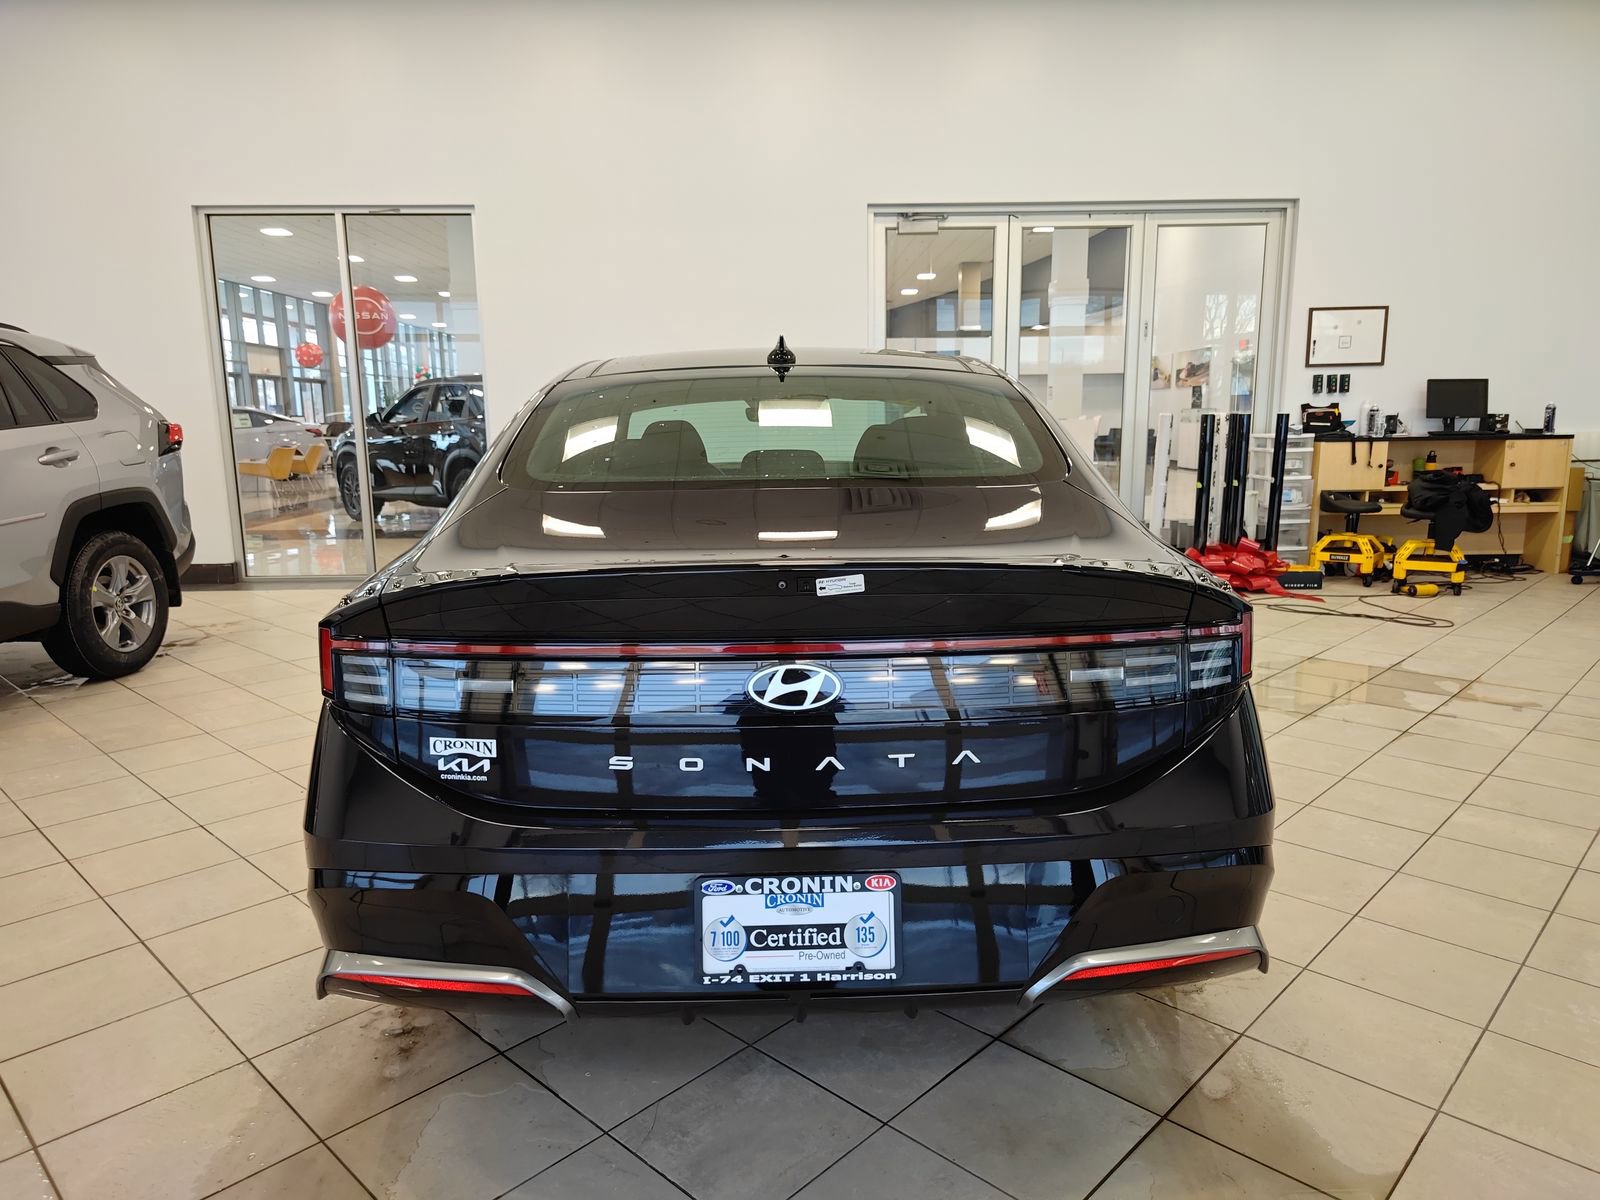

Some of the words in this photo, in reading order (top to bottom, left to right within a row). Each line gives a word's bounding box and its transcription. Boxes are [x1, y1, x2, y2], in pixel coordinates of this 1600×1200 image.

[337, 312, 389, 321] NSSAN
[433, 739, 493, 756] CRONIN
[438, 757, 491, 773] KIA
[608, 749, 982, 772] SONATA
[440, 773, 488, 782] croninkia.com
[745, 876, 852, 894] CRONIN
[870, 878, 892, 888] KIA
[766, 894, 822, 908] CRONIN
[710, 931, 716, 947] 7
[721, 930, 740, 946] 100
[750, 928, 842, 948] Certified
[856, 926, 875, 943] 135
[798, 950, 846, 961] Pre-Owned
[703, 975, 744, 984] I-74
[749, 974, 794, 983] EXIT
[800, 974, 810, 982] 1
[816, 972, 896, 982] Harrison
